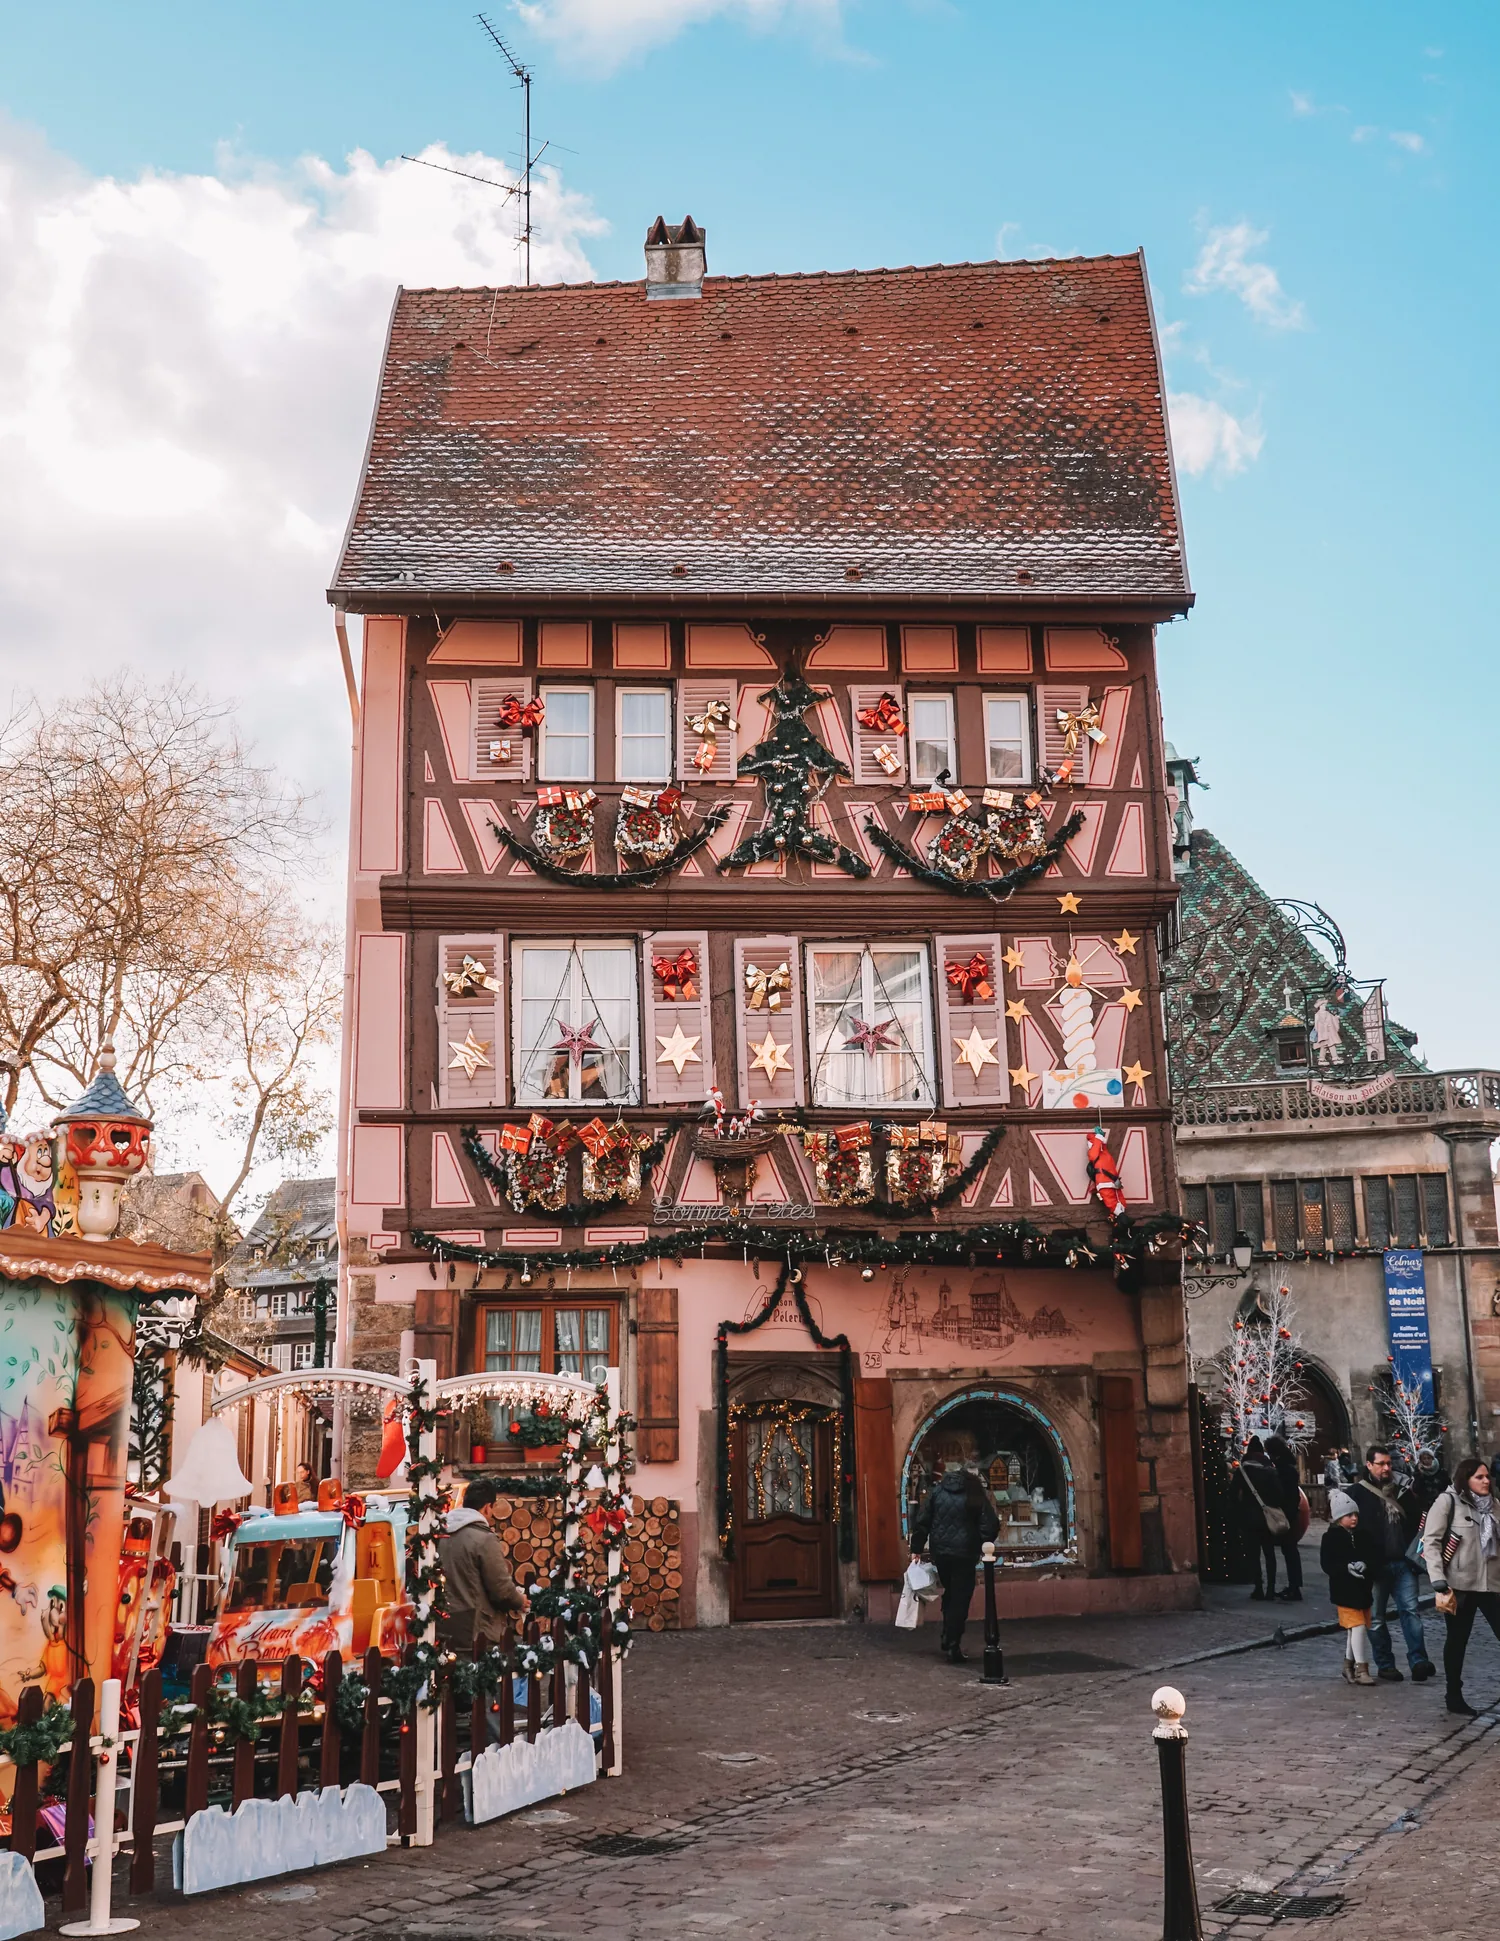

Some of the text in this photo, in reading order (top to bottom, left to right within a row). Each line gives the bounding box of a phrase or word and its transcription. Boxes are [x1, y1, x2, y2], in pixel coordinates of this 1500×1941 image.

[1313, 1084, 1344, 1101] Maison
[1386, 1255, 1422, 1267] Colmar
[1388, 1287, 1424, 1295] Marché
[1389, 1297, 1425, 1306] de Noël
[241, 1620, 298, 1641] Miami
[237, 1640, 291, 1660] Beach
